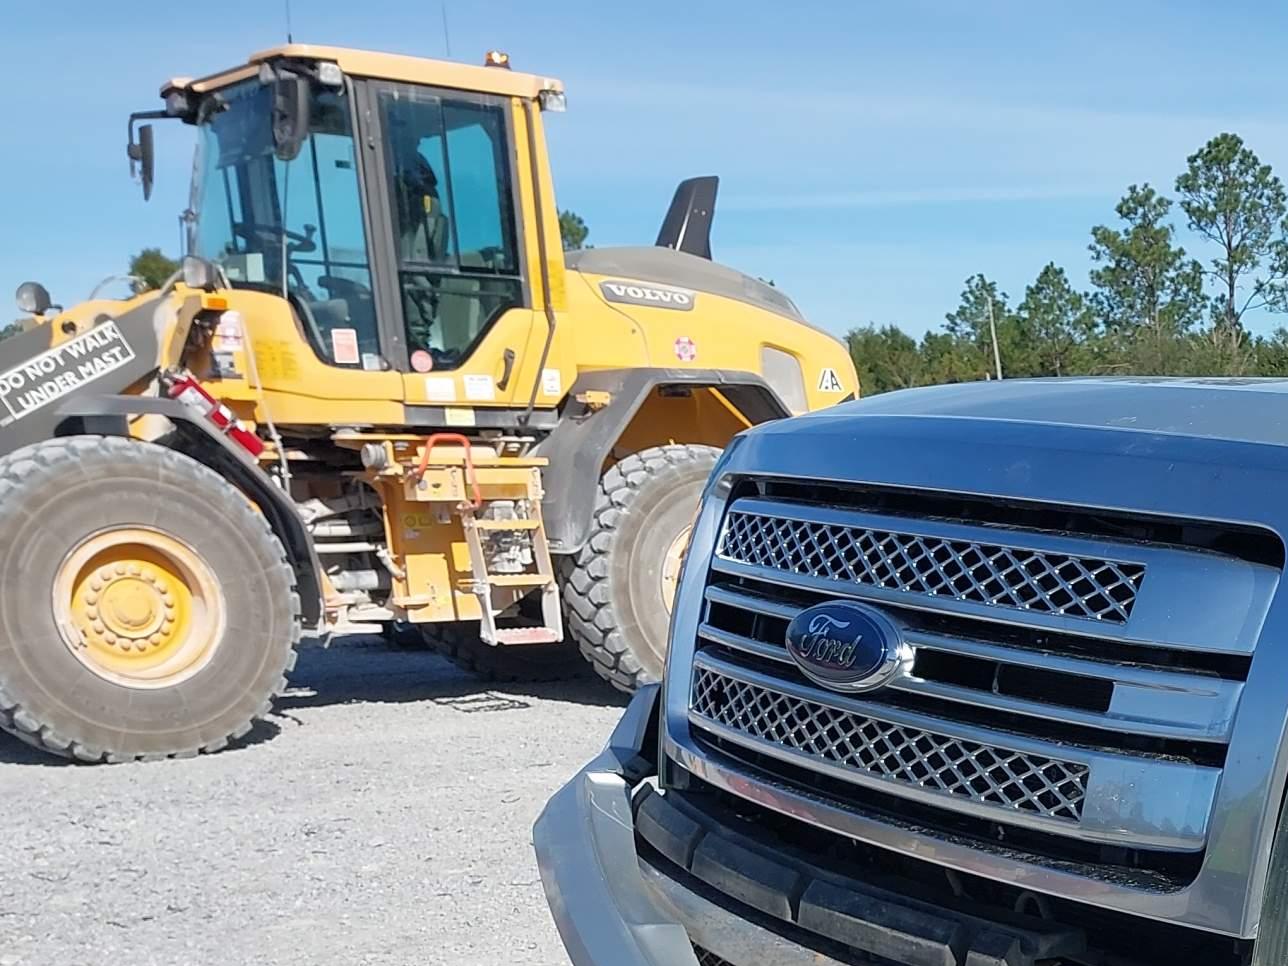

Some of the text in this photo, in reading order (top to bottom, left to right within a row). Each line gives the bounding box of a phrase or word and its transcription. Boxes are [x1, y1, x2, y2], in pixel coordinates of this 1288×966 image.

[606, 283, 690, 304] VOLVO
[17, 345, 127, 410] UNDER MAST
[25, 350, 69, 381] NOT
[65, 325, 120, 361] WALK
[800, 614, 863, 668] Ford
